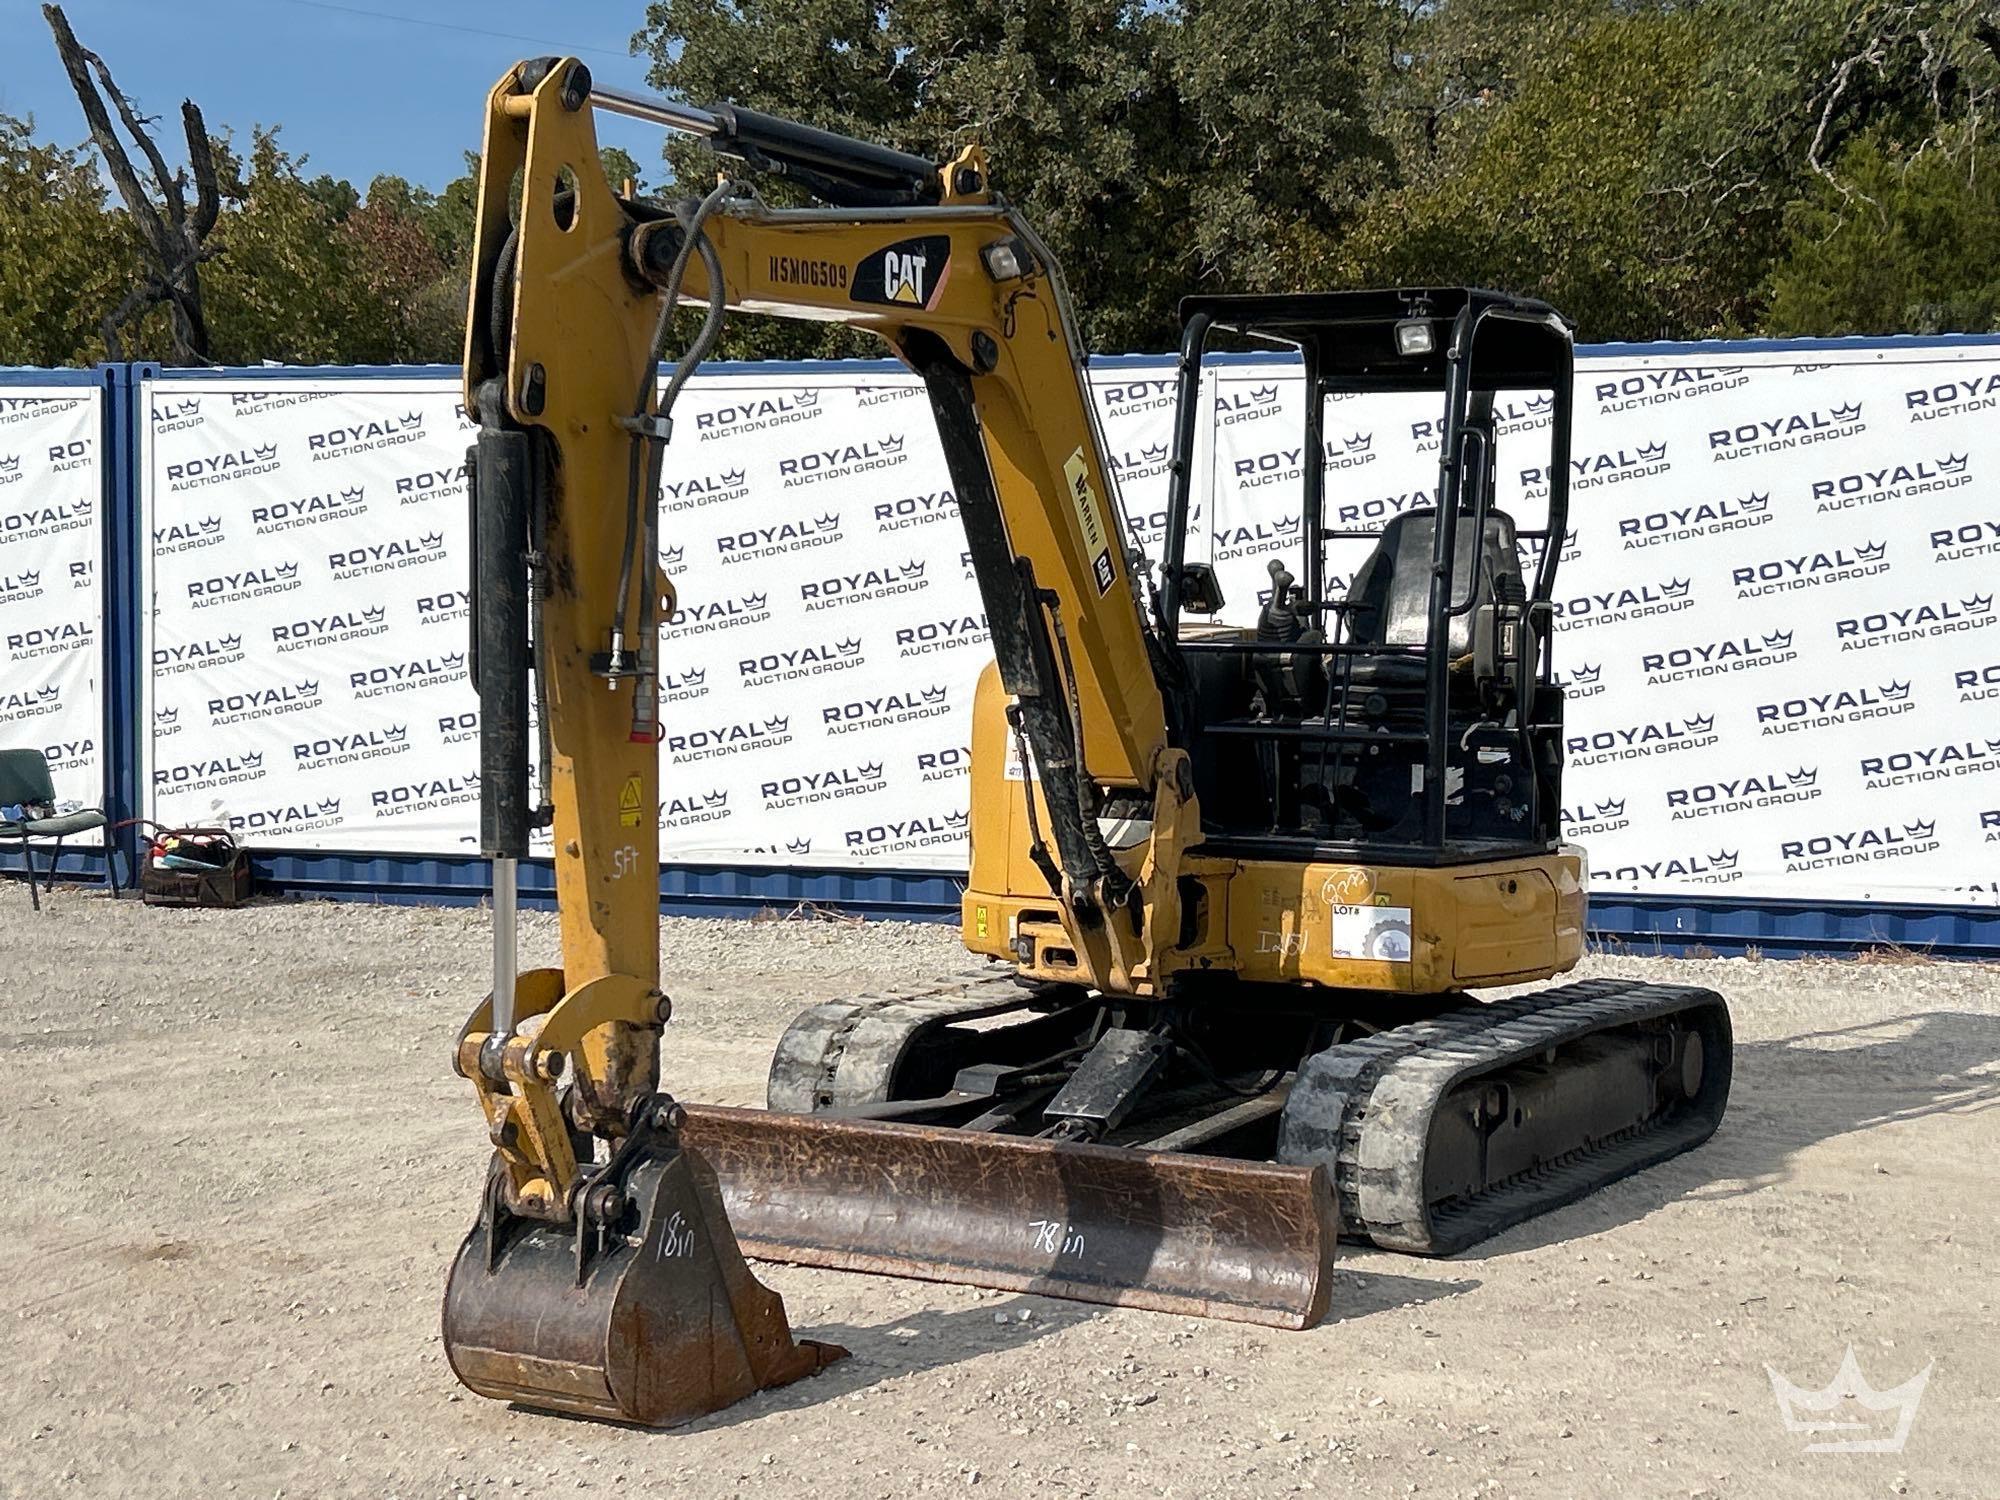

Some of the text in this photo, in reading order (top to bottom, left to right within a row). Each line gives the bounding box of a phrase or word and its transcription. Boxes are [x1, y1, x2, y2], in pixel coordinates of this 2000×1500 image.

[884, 251, 926, 304] CAT
[1601, 376, 1749, 415] AUCTION GROUP
[1905, 374, 2000, 409] ROYA
[32, 401, 78, 417] GROUP
[235, 398, 297, 418] AUCTION
[696, 397, 793, 429] ROYAL
[1224, 405, 1282, 426] GROUP
[1910, 397, 1996, 423] AUCTION
[158, 417, 205, 434] GROUP
[309, 420, 399, 450] ROYAL
[701, 408, 822, 441] AUCTION GROUP
[1709, 412, 1830, 449] ROYAL
[313, 431, 425, 462] AUCTION GROUP
[1714, 424, 1866, 462] AUCTION GROUP
[167, 451, 255, 480] ROYAL
[780, 440, 880, 476] ROYAL
[784, 455, 907, 488] AUCTION GROUP
[171, 462, 280, 491] AUCTION GROUP
[396, 466, 468, 493] ROYA
[1239, 468, 1305, 490] AUCTIO
[1608, 463, 1670, 483] GROUP
[1812, 460, 1938, 500] ROYAL
[252, 491, 343, 523] ROYAL
[400, 485, 463, 506] AUCTION
[697, 488, 749, 507] GROUP
[874, 491, 957, 520] ROYA
[1817, 475, 1972, 513] AUCTION GROUP
[0, 506, 72, 532] OYAL
[257, 505, 367, 535] AUCTION GROUP
[878, 511, 947, 532] AUCTION
[1075, 473, 1098, 545] WARREN
[1619, 498, 1740, 537] ROYAL
[0, 518, 93, 544] UCTION GROU
[153, 523, 199, 543] YAL
[178, 535, 225, 552] GROUP
[717, 519, 816, 553] ROYAL
[1214, 523, 1273, 548] YAL
[1624, 514, 1773, 550] AUCTION GROUP
[1930, 521, 2000, 549] ROY
[329, 540, 420, 569] ROYAL
[722, 533, 843, 565] AUCTION GROUP
[1935, 542, 2000, 563] AUCTIO
[334, 551, 446, 581] AUCTION GROUP
[1096, 555, 1111, 587] CAT
[1733, 550, 1855, 586] ROYAL
[188, 567, 277, 598] ROYAL
[192, 581, 301, 609] AUCTION GROUP
[801, 566, 902, 600] ROYAL
[1738, 563, 1890, 599] AUCTION GROUP
[417, 589, 472, 613] ROY
[806, 580, 928, 612] AUCTION GROUP
[1631, 600, 1694, 618] GROUP
[272, 610, 364, 642] ROYAL
[421, 608, 471, 625] AUCTIO
[660, 612, 771, 641] UCTION GROUP
[662, 600, 742, 628] OYAL
[1836, 603, 1961, 638] ROYAL
[7, 621, 93, 649] ROYAL
[277, 625, 389, 653] AUCTION GROUP
[900, 635, 968, 658] AUCTION
[1841, 616, 1997, 652] AUCTION GROUP
[11, 642, 69, 661] AUCTION
[153, 641, 220, 665] OYAL
[198, 652, 246, 669] GROUP
[739, 643, 838, 676] ROYAL
[1642, 638, 1762, 672] ROYAL
[350, 659, 441, 688] ROYAL
[355, 667, 468, 699] AUCTION GROUP
[744, 658, 864, 688] AUCTION GROUP
[1648, 652, 1797, 685] AUCTION GROUP
[17, 703, 63, 720] GROUP
[208, 687, 296, 715] ROYAL
[212, 699, 322, 726] AUCTION GROUP
[822, 693, 921, 724] ROYAL
[1757, 689, 1879, 723] ROYAL
[827, 705, 950, 736] AUCTION GROUP
[1762, 702, 1915, 736] AUCTION GROUP
[293, 729, 385, 759] ROYAL
[669, 723, 765, 752] ROYAL
[673, 735, 792, 764] AUCTION GROUP
[1567, 722, 1684, 754] ROYAL
[1571, 736, 1718, 767] AUCTION GROUP
[154, 757, 241, 785] ROYAL
[298, 744, 410, 771] AUCTION GROUP
[1860, 742, 1986, 776] ROYAL
[157, 770, 266, 797] AUCTION GROUP
[761, 767, 860, 798] ROYAL
[922, 766, 971, 782] AUCTI
[1866, 768, 1950, 790] AUCTION
[372, 776, 464, 806] ROYAL
[765, 781, 887, 810] AUCTION GROUP
[1667, 772, 1788, 807] ROYAL
[229, 804, 318, 831] ROYAL
[376, 792, 481, 817] AUCTION GROU
[680, 809, 731, 826] GROUP
[1672, 789, 1821, 821] AUCTION GROUP
[845, 818, 944, 847] ROYAL
[1567, 819, 1630, 837] GROUP
[1781, 825, 1906, 859] ROYAL
[1786, 841, 1940, 873] AUCTION GROUP
